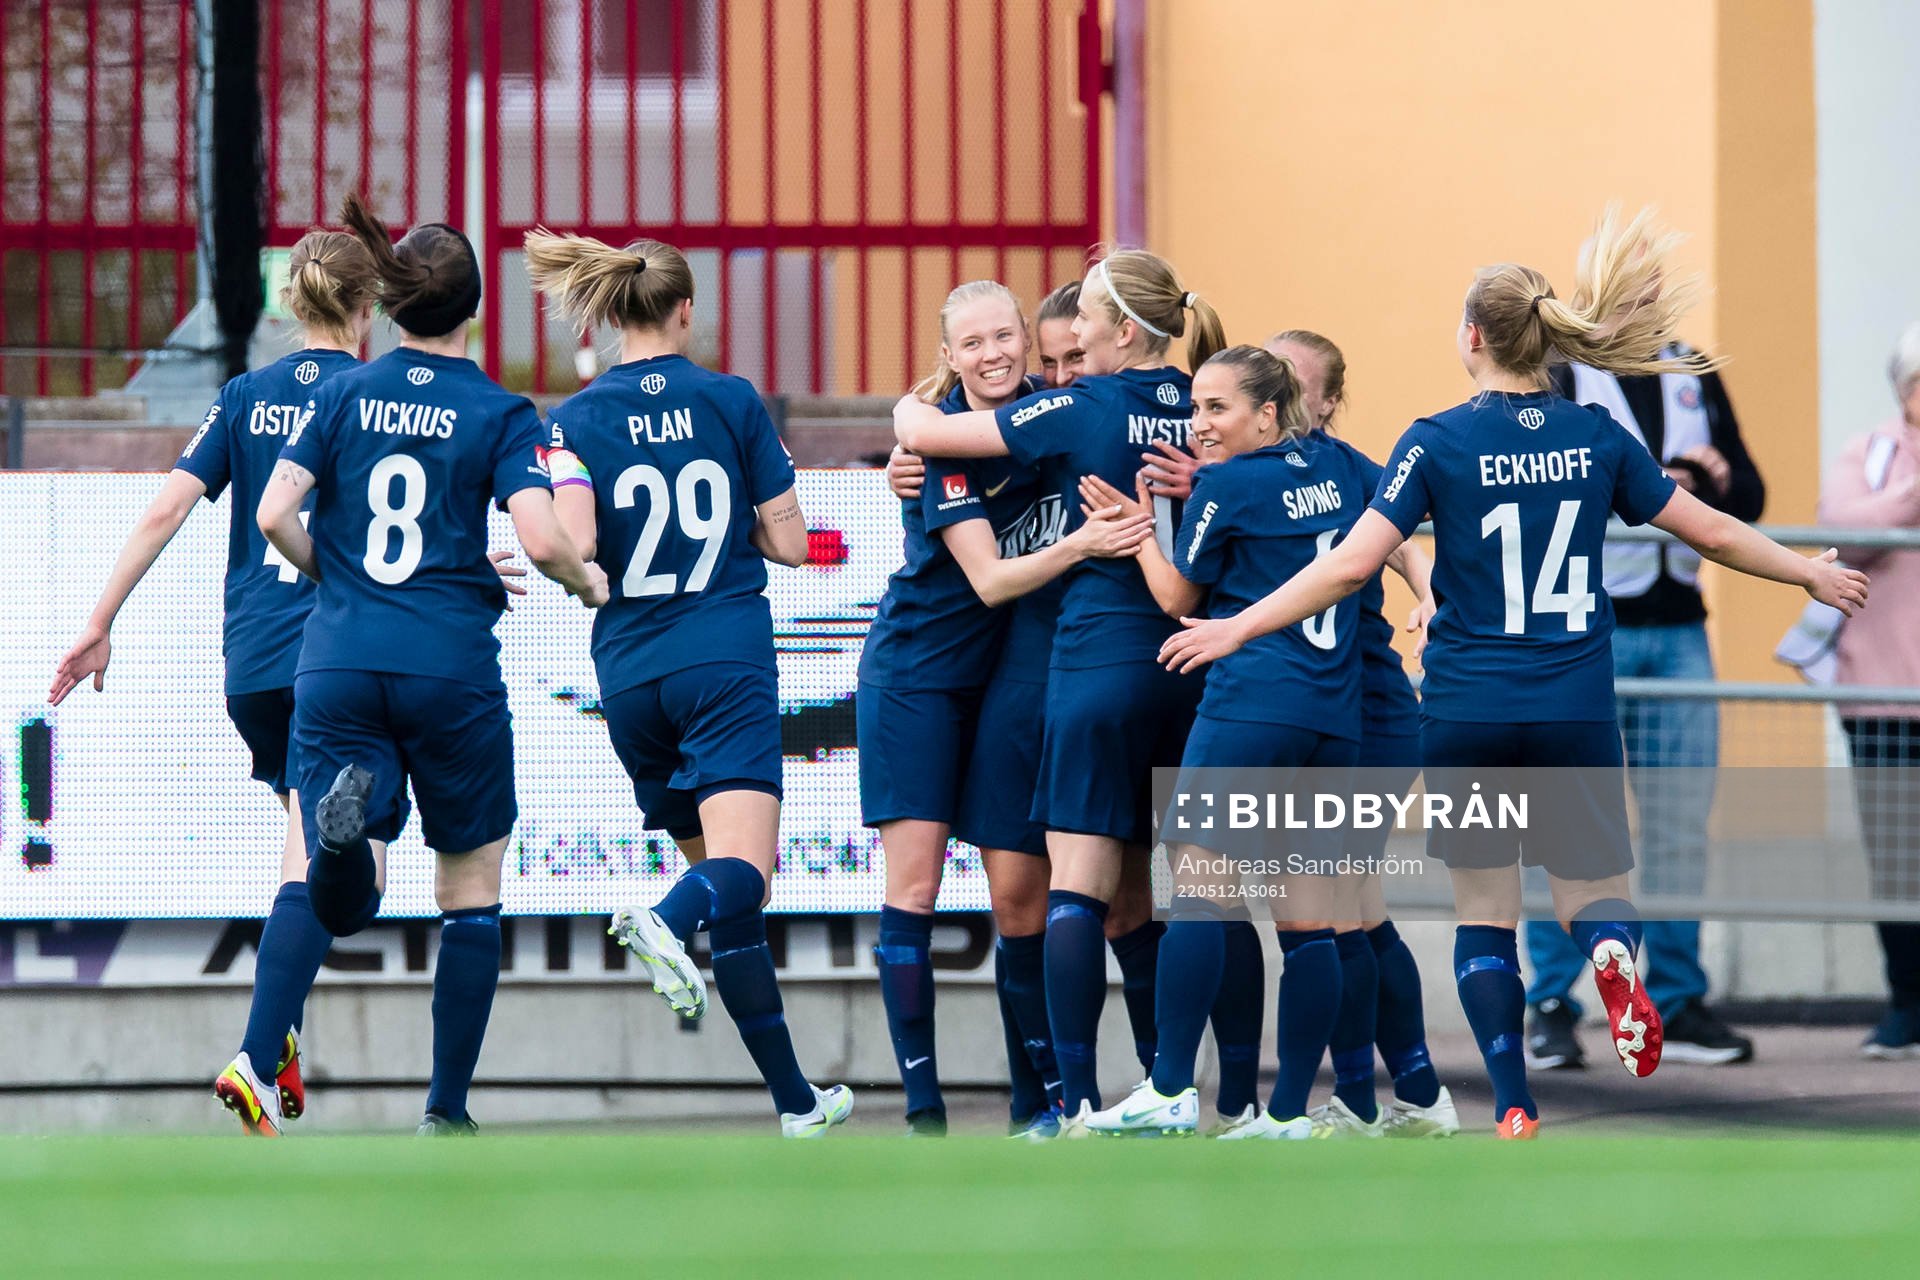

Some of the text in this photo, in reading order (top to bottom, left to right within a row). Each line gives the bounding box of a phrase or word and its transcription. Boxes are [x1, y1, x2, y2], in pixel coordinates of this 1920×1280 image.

[359, 398, 457, 439] VICKIUS
[627, 407, 694, 445] PLAN
[1010, 394, 1074, 427] stadium
[1383, 444, 1425, 503] stadium
[1479, 447, 1592, 486] ECKHOFF
[362, 453, 427, 585] 8
[1282, 479, 1342, 520] SAVING
[612, 458, 732, 598] 29
[1186, 500, 1220, 565] stadium
[1481, 500, 1596, 635] 14
